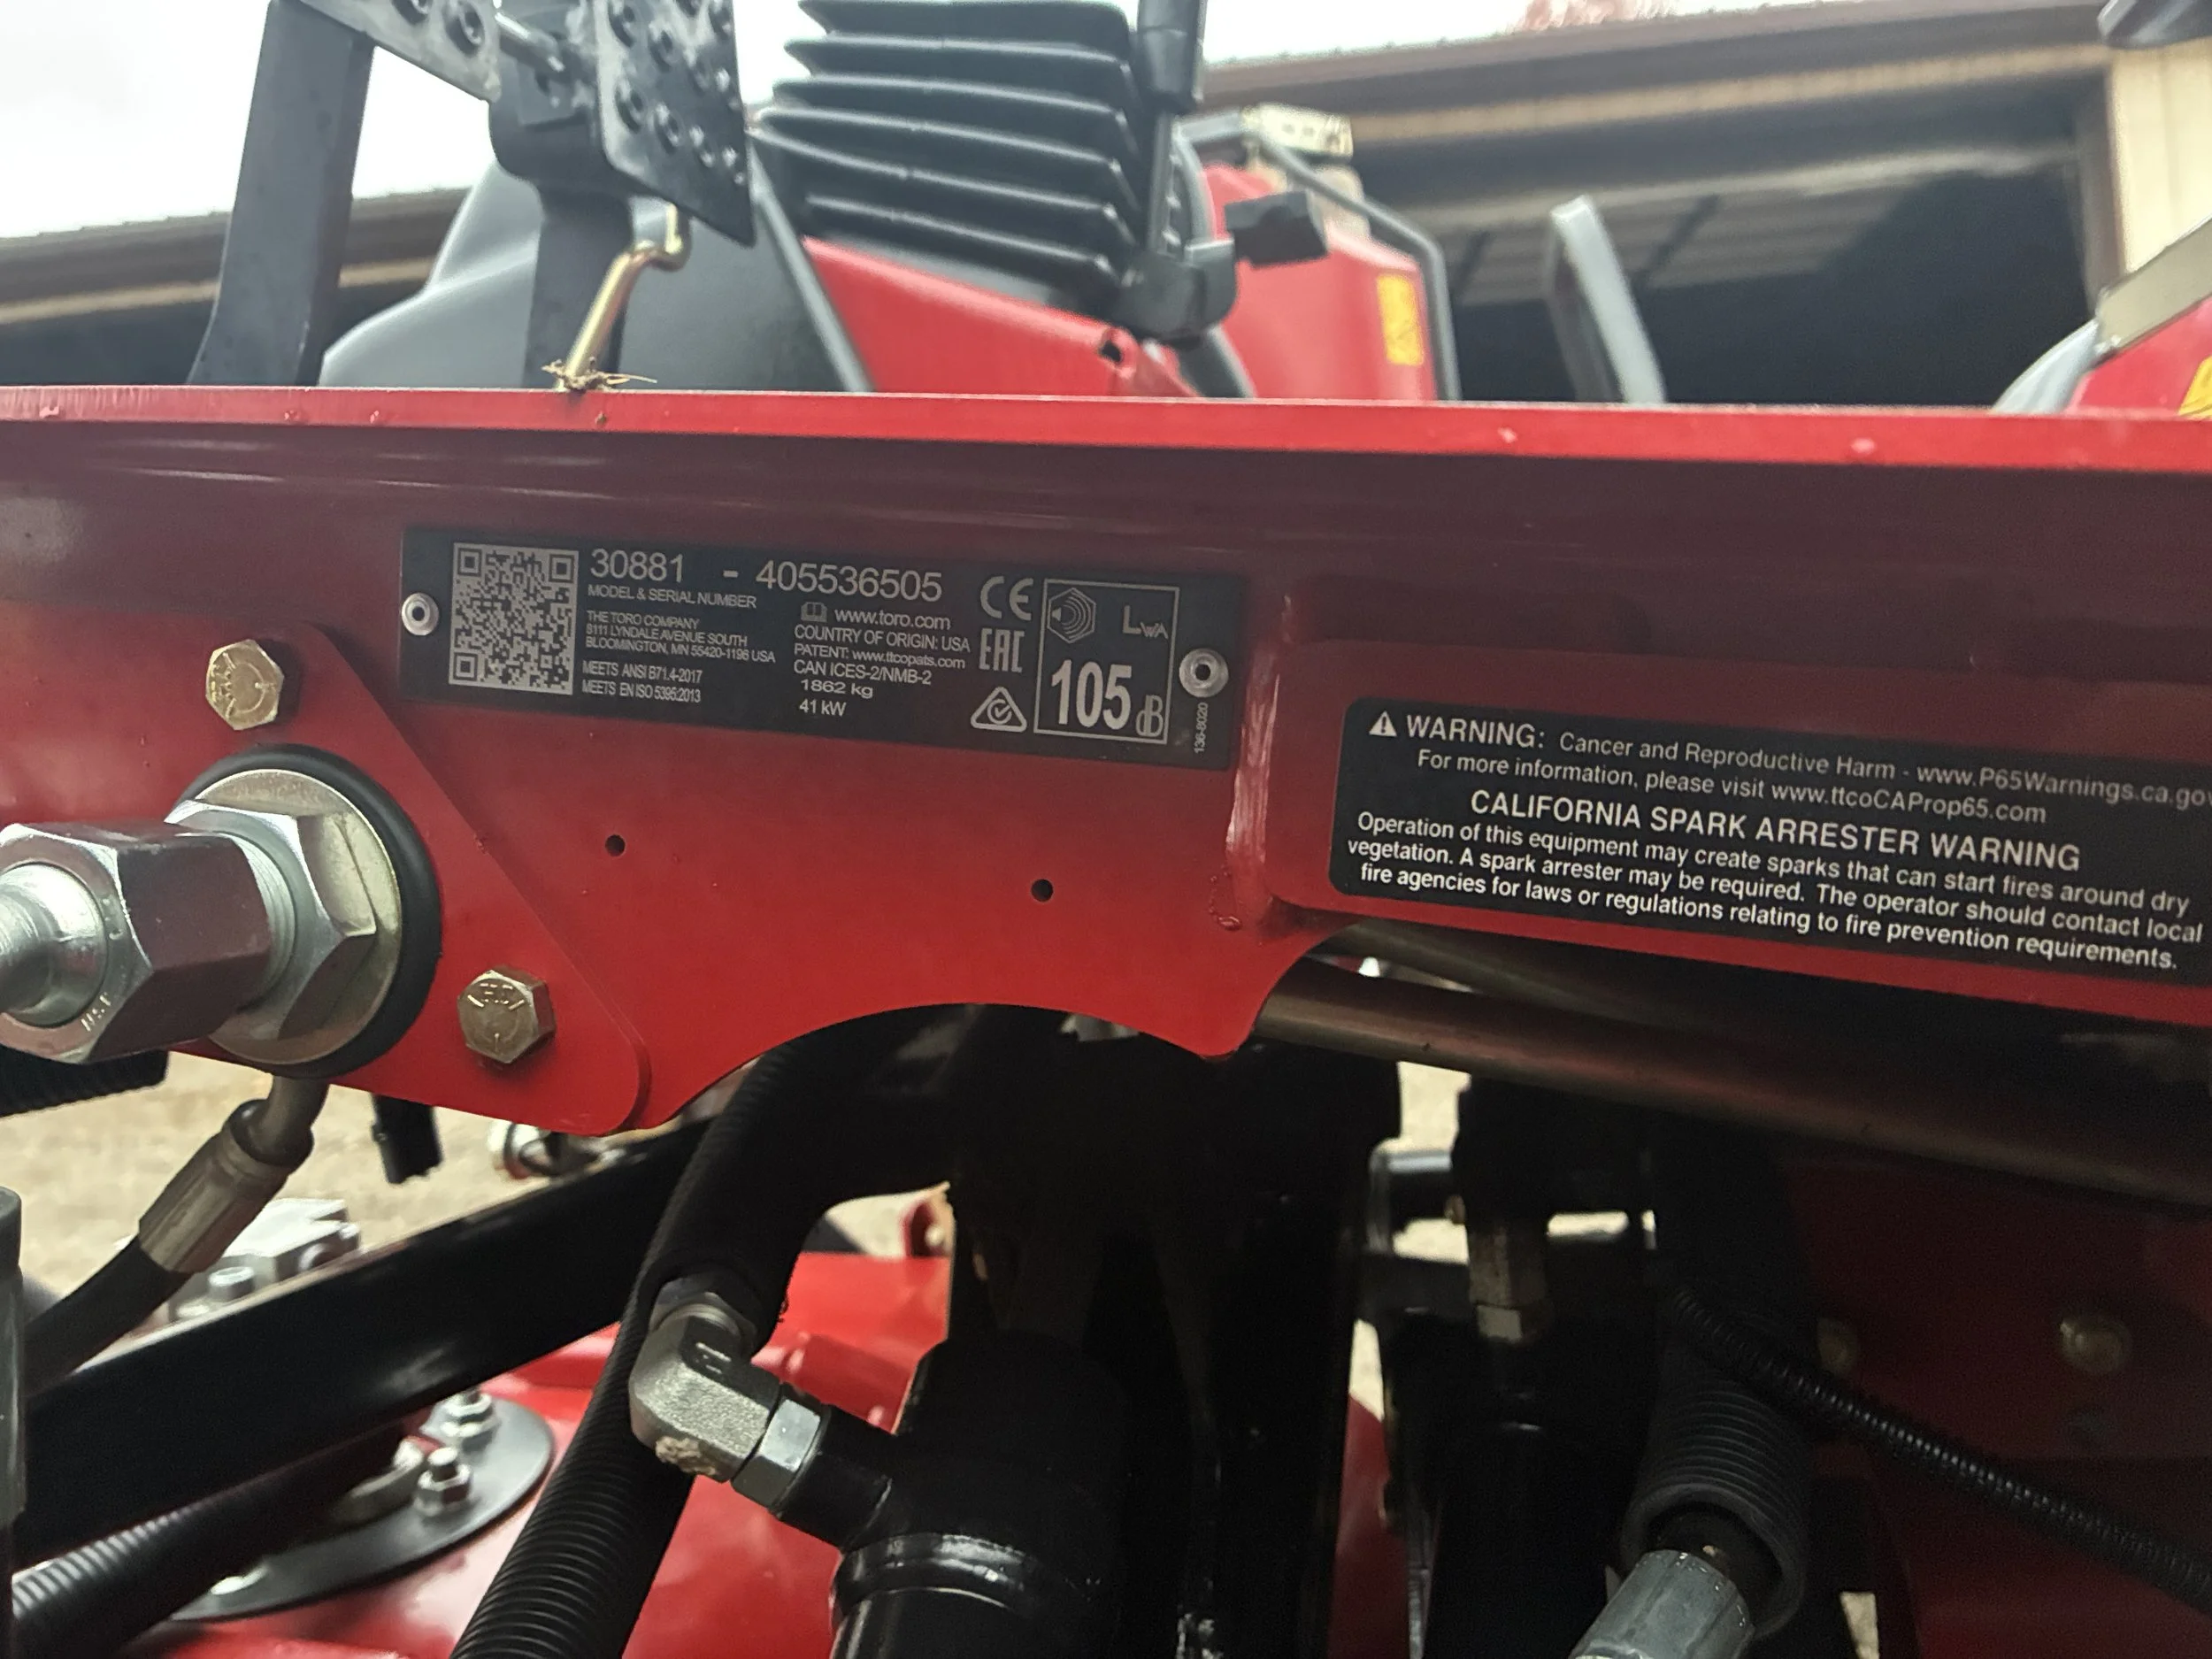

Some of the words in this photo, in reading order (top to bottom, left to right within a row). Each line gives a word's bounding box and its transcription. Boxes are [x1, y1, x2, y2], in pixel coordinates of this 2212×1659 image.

[590, 548, 683, 583] 30881
[756, 559, 942, 603] 405536505
[588, 584, 634, 600] MODEL
[636, 588, 646, 600] &
[649, 588, 695, 604] SERIAL
[697, 592, 757, 609] NUMBER
[587, 611, 609, 623] THE
[611, 612, 641, 625] TORO
[644, 614, 700, 629] COMPANY
[834, 607, 950, 630] www.toro.com
[586, 624, 608, 635] 8111
[611, 626, 659, 640] LYNDALE
[660, 629, 705, 644] AVENUE
[708, 633, 748, 647] SOUTH
[794, 624, 862, 643] COUNTRY
[864, 629, 884, 645] OF
[887, 631, 938, 650] ORIGIN:
[941, 636, 971, 653] USA
[586, 636, 668, 655] BLOOMINGTON,
[671, 643, 690, 656] MN
[751, 649, 776, 663] USA
[794, 643, 849, 659] PATENT:
[852, 650, 965, 669] www.ttcopats.com
[582, 660, 618, 676] MEETS
[621, 664, 648, 679] ANSI
[794, 659, 826, 676] CAN
[830, 662, 932, 685] ICES-2/NMB-2
[581, 680, 616, 695] MEETS
[619, 682, 634, 697] EN
[635, 684, 653, 699] ISO
[801, 680, 846, 695] 1862
[850, 683, 873, 699] kg
[1051, 659, 1132, 730] 105
[1136, 695, 1164, 737] dB
[799, 699, 816, 713] 41
[821, 700, 847, 717] kW
[1406, 714, 1545, 749] WARNING:
[1560, 732, 1633, 757] Cancer
[1640, 741, 1678, 760] and
[1685, 741, 1829, 775] Reproductive
[1836, 756, 1896, 779] Harm
[1418, 749, 1450, 770] For
[1457, 757, 1509, 775] more
[1515, 757, 1638, 788] information,
[1646, 770, 1715, 794] please
[1722, 777, 1765, 798] visit
[1771, 785, 2047, 824] www.ttcoCAProp65.com
[1471, 789, 1641, 829] CALIFORNIA
[1650, 806, 1747, 839] SPARK
[1755, 817, 1920, 856] ARRESTER
[1931, 832, 2080, 872] WARNING
[1358, 811, 1454, 839] Operation
[1460, 822, 1481, 841] of
[1486, 826, 1523, 846] this
[1529, 832, 1639, 858] equipment
[1645, 843, 1688, 868] may
[1694, 849, 1761, 870] create
[1767, 855, 1840, 879] sparks
[1847, 861, 1889, 883] that
[1896, 868, 1937, 888] can
[1944, 871, 1996, 895] start
[2002, 874, 2054, 901] fires
[2060, 886, 2145, 910] around
[2151, 891, 2191, 918] dry
[1348, 839, 1454, 864] vegetation.
[1459, 847, 1474, 866] A
[1479, 851, 1536, 874] spark
[1541, 858, 1624, 883] arrester
[1629, 868, 1672, 892] may
[1678, 870, 1705, 891] be
[1710, 876, 1805, 902] required.
[1816, 883, 1857, 906] The
[1863, 893, 1960, 917] operator
[1965, 901, 2046, 927] should
[2051, 910, 2140, 937] contact
[2147, 918, 2203, 944] local
[1361, 863, 1393, 884] fire
[1397, 869, 1486, 893] agencies
[1492, 876, 1520, 897] for
[1525, 880, 1571, 902] laws
[1578, 889, 1599, 905] or
[1605, 893, 1724, 919] regulations
[1730, 904, 1810, 933] relating
[1817, 911, 1839, 932] to
[1845, 914, 1881, 937] fire
[1886, 922, 2009, 951] prevention
[2016, 937, 2177, 970] requirements.
